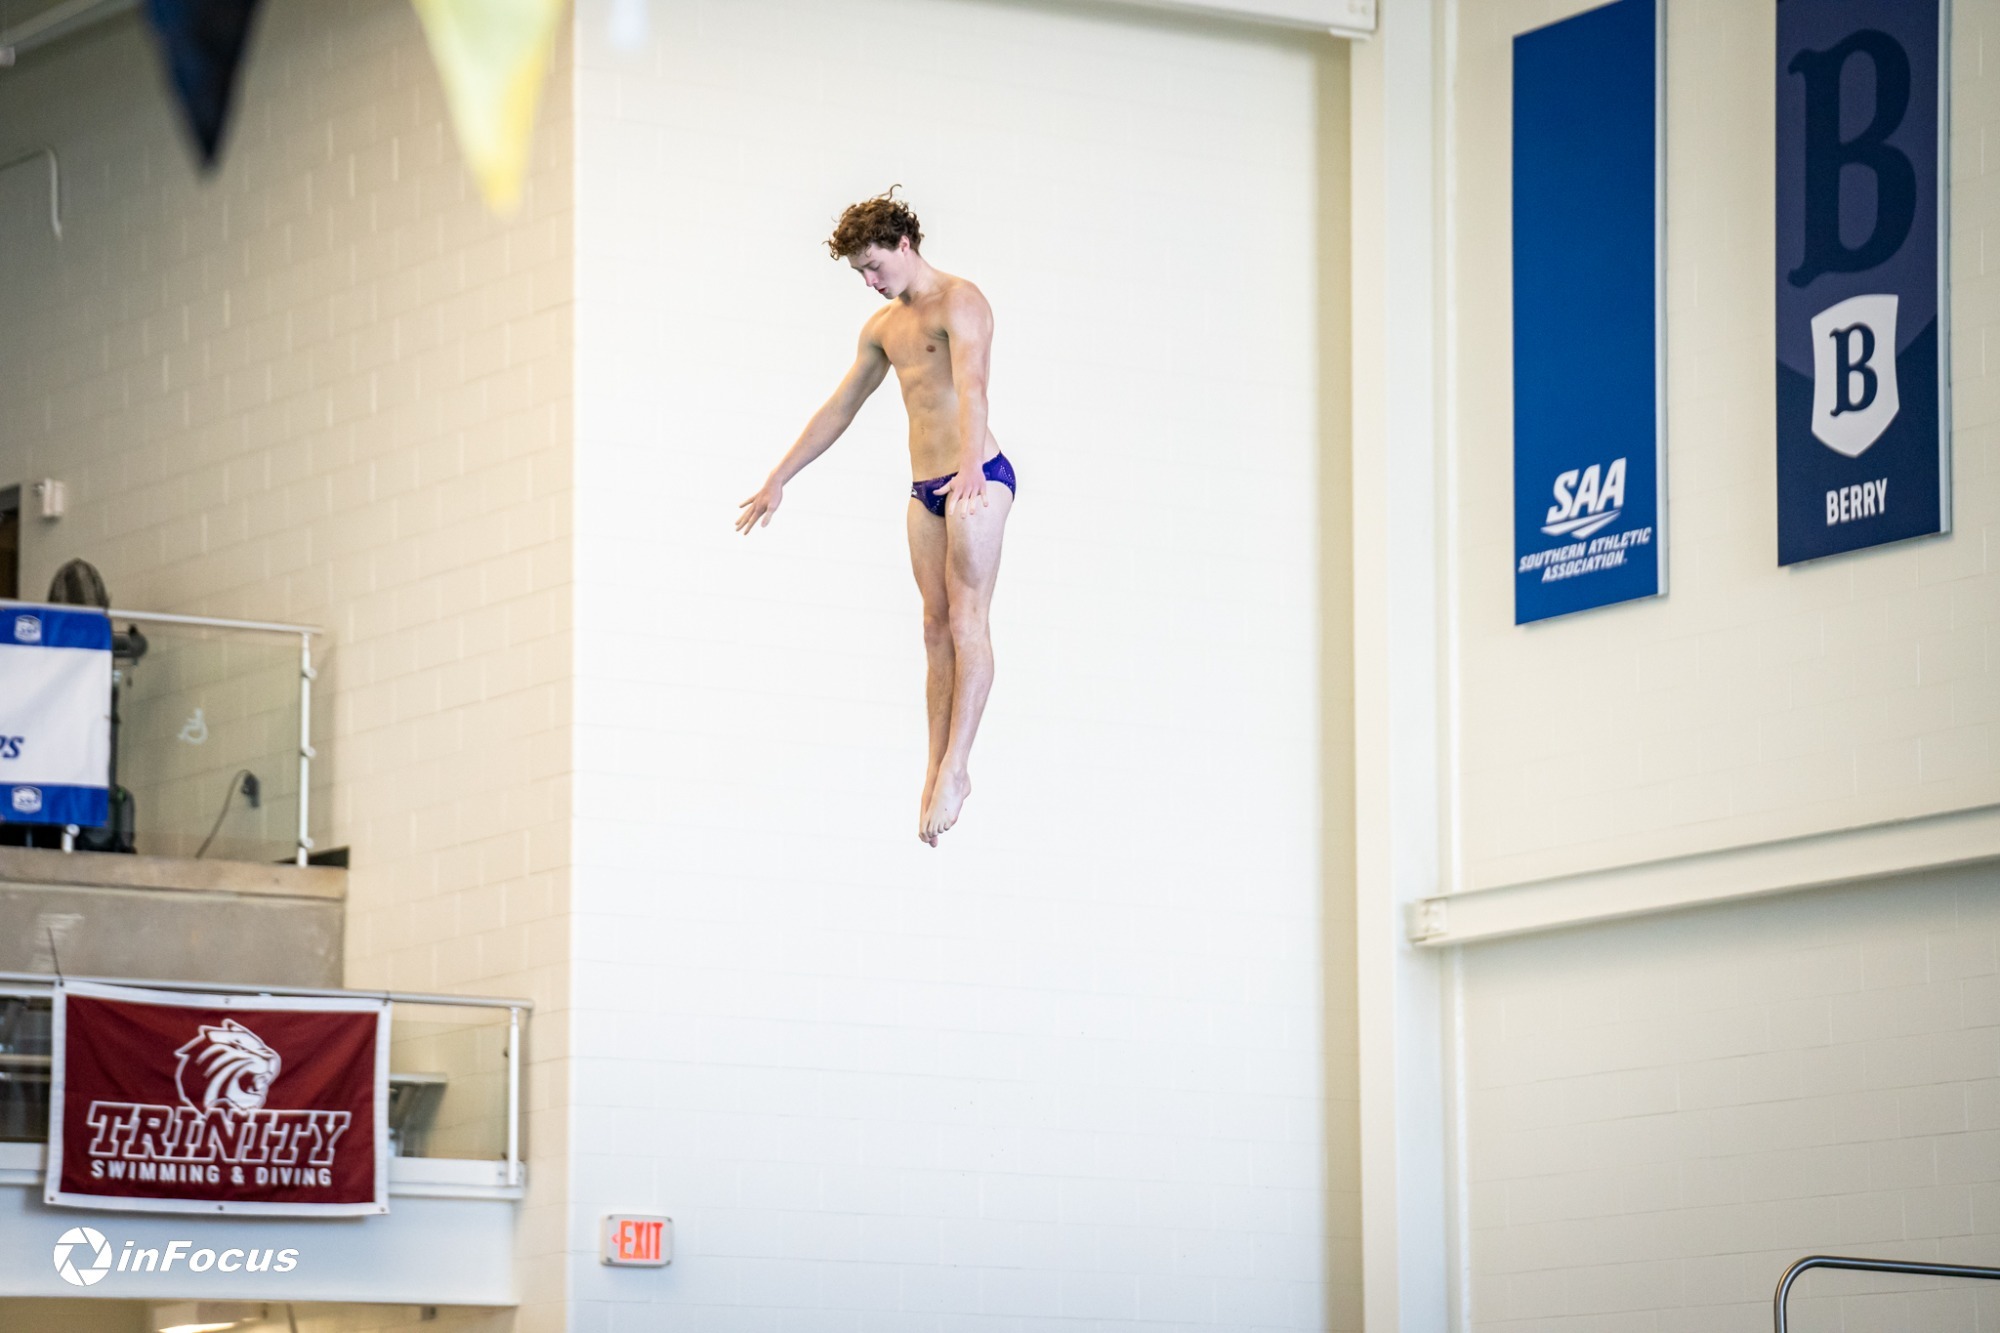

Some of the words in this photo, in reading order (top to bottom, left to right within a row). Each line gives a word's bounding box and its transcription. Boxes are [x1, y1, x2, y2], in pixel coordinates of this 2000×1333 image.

[1787, 28, 1917, 288] B
[1829, 321, 1878, 417] B
[1546, 456, 1627, 525] SAA
[1826, 477, 1888, 526] BERRY
[1518, 541, 1587, 573] SOUTHERN
[1587, 526, 1652, 555] ATHLETIC
[1541, 549, 1625, 584] ASSOCIATION
[86, 1100, 352, 1166] TRINITY
[91, 1159, 220, 1184] SWIMMING
[230, 1166, 245, 1185] &
[256, 1166, 332, 1187] DIVING
[619, 1220, 664, 1260] EXIT
